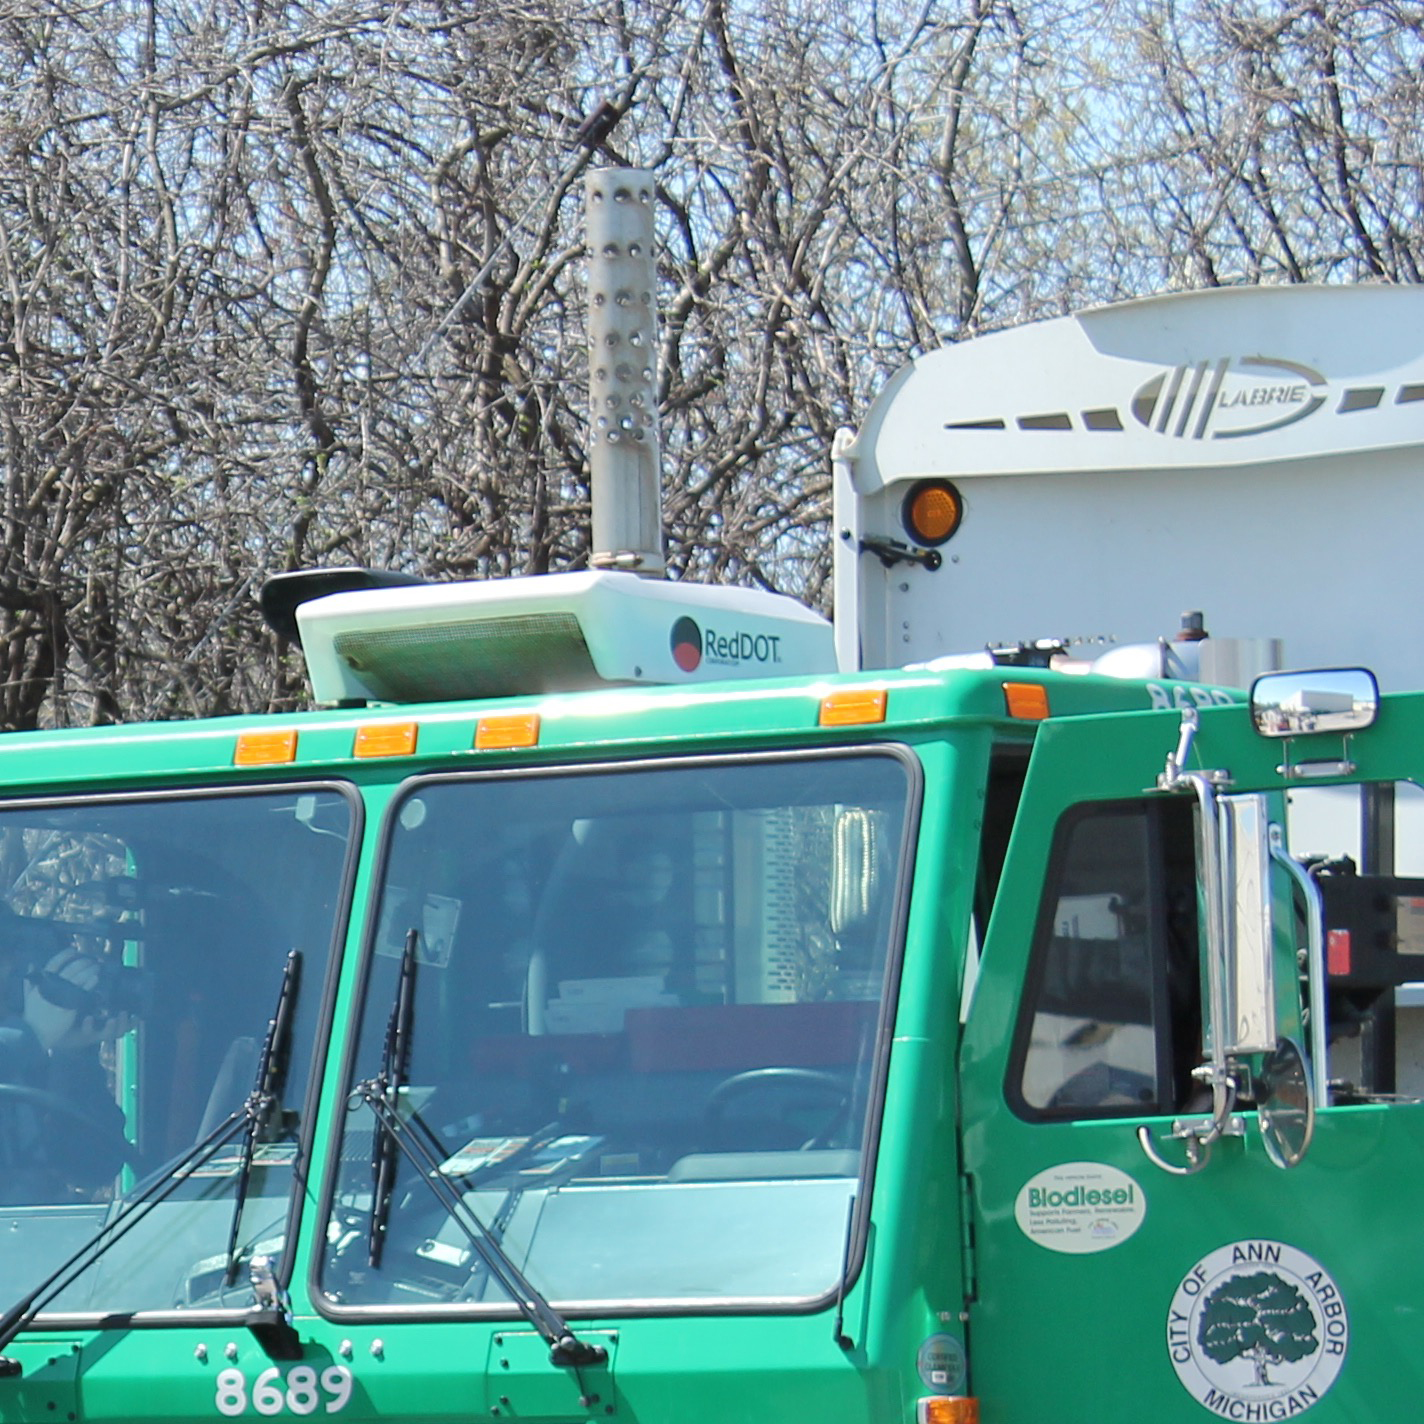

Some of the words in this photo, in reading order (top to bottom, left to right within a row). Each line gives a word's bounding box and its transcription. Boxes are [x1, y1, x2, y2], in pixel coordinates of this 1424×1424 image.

[1217, 385, 1307, 408] LABRIE
[704, 628, 781, 663] RedDOT
[1028, 1183, 1135, 1208] Biodiesel
[1169, 1310, 1192, 1364] CITY
[1182, 1264, 1208, 1296] OF
[1232, 1242, 1281, 1264] ANN
[1304, 1270, 1345, 1357] ARBOR
[214, 1364, 353, 1417] 8689
[1203, 1384, 1320, 1422] MICHIGAN
